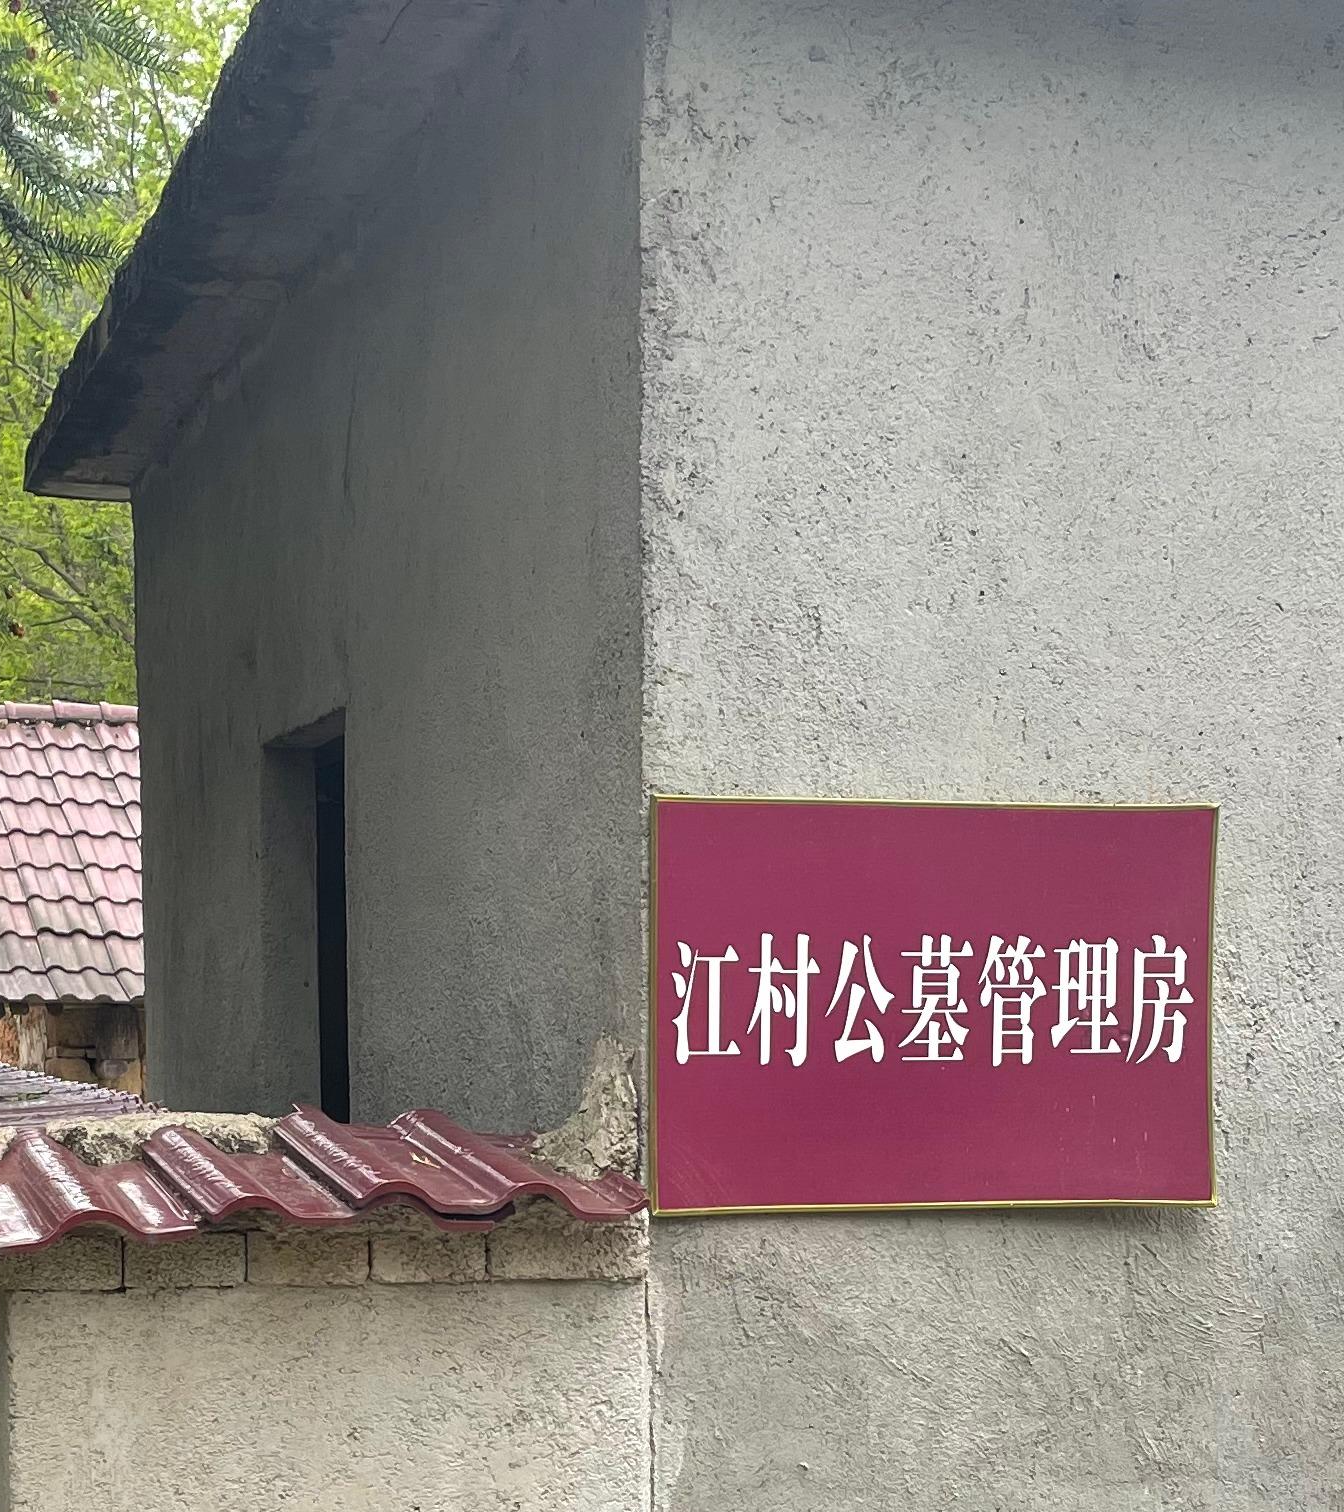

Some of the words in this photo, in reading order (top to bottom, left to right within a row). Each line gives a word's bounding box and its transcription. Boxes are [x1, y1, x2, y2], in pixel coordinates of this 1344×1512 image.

[671, 932, 1194, 1066] 江村公墓管理房
